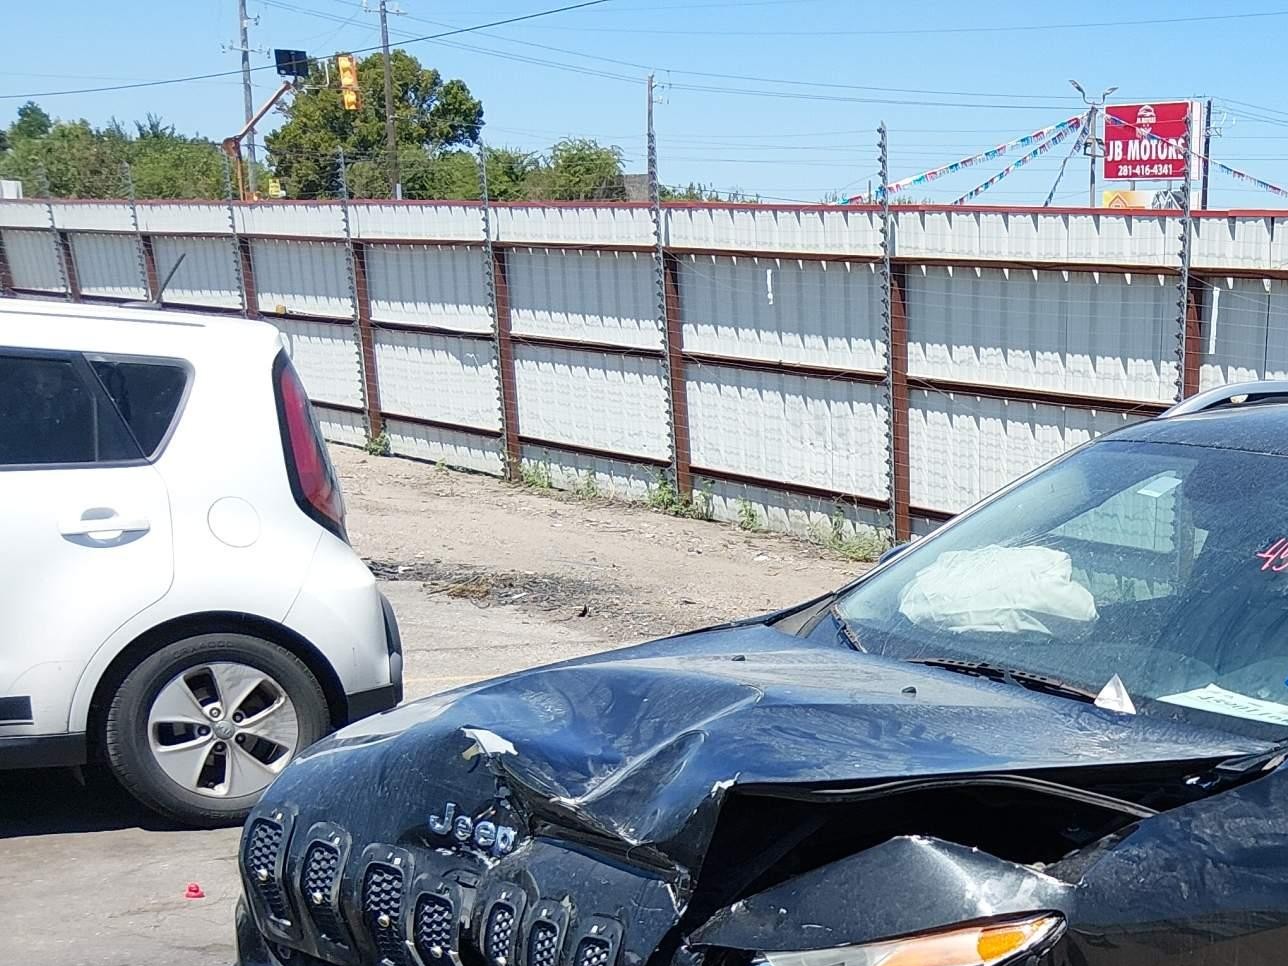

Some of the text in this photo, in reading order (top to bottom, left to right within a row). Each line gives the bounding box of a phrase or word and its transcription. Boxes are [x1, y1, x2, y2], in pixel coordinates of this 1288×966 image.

[1107, 138, 1185, 161] JB MOTORS
[1118, 164, 1173, 176] 281-416-4341
[429, 802, 517, 855] Jeep
